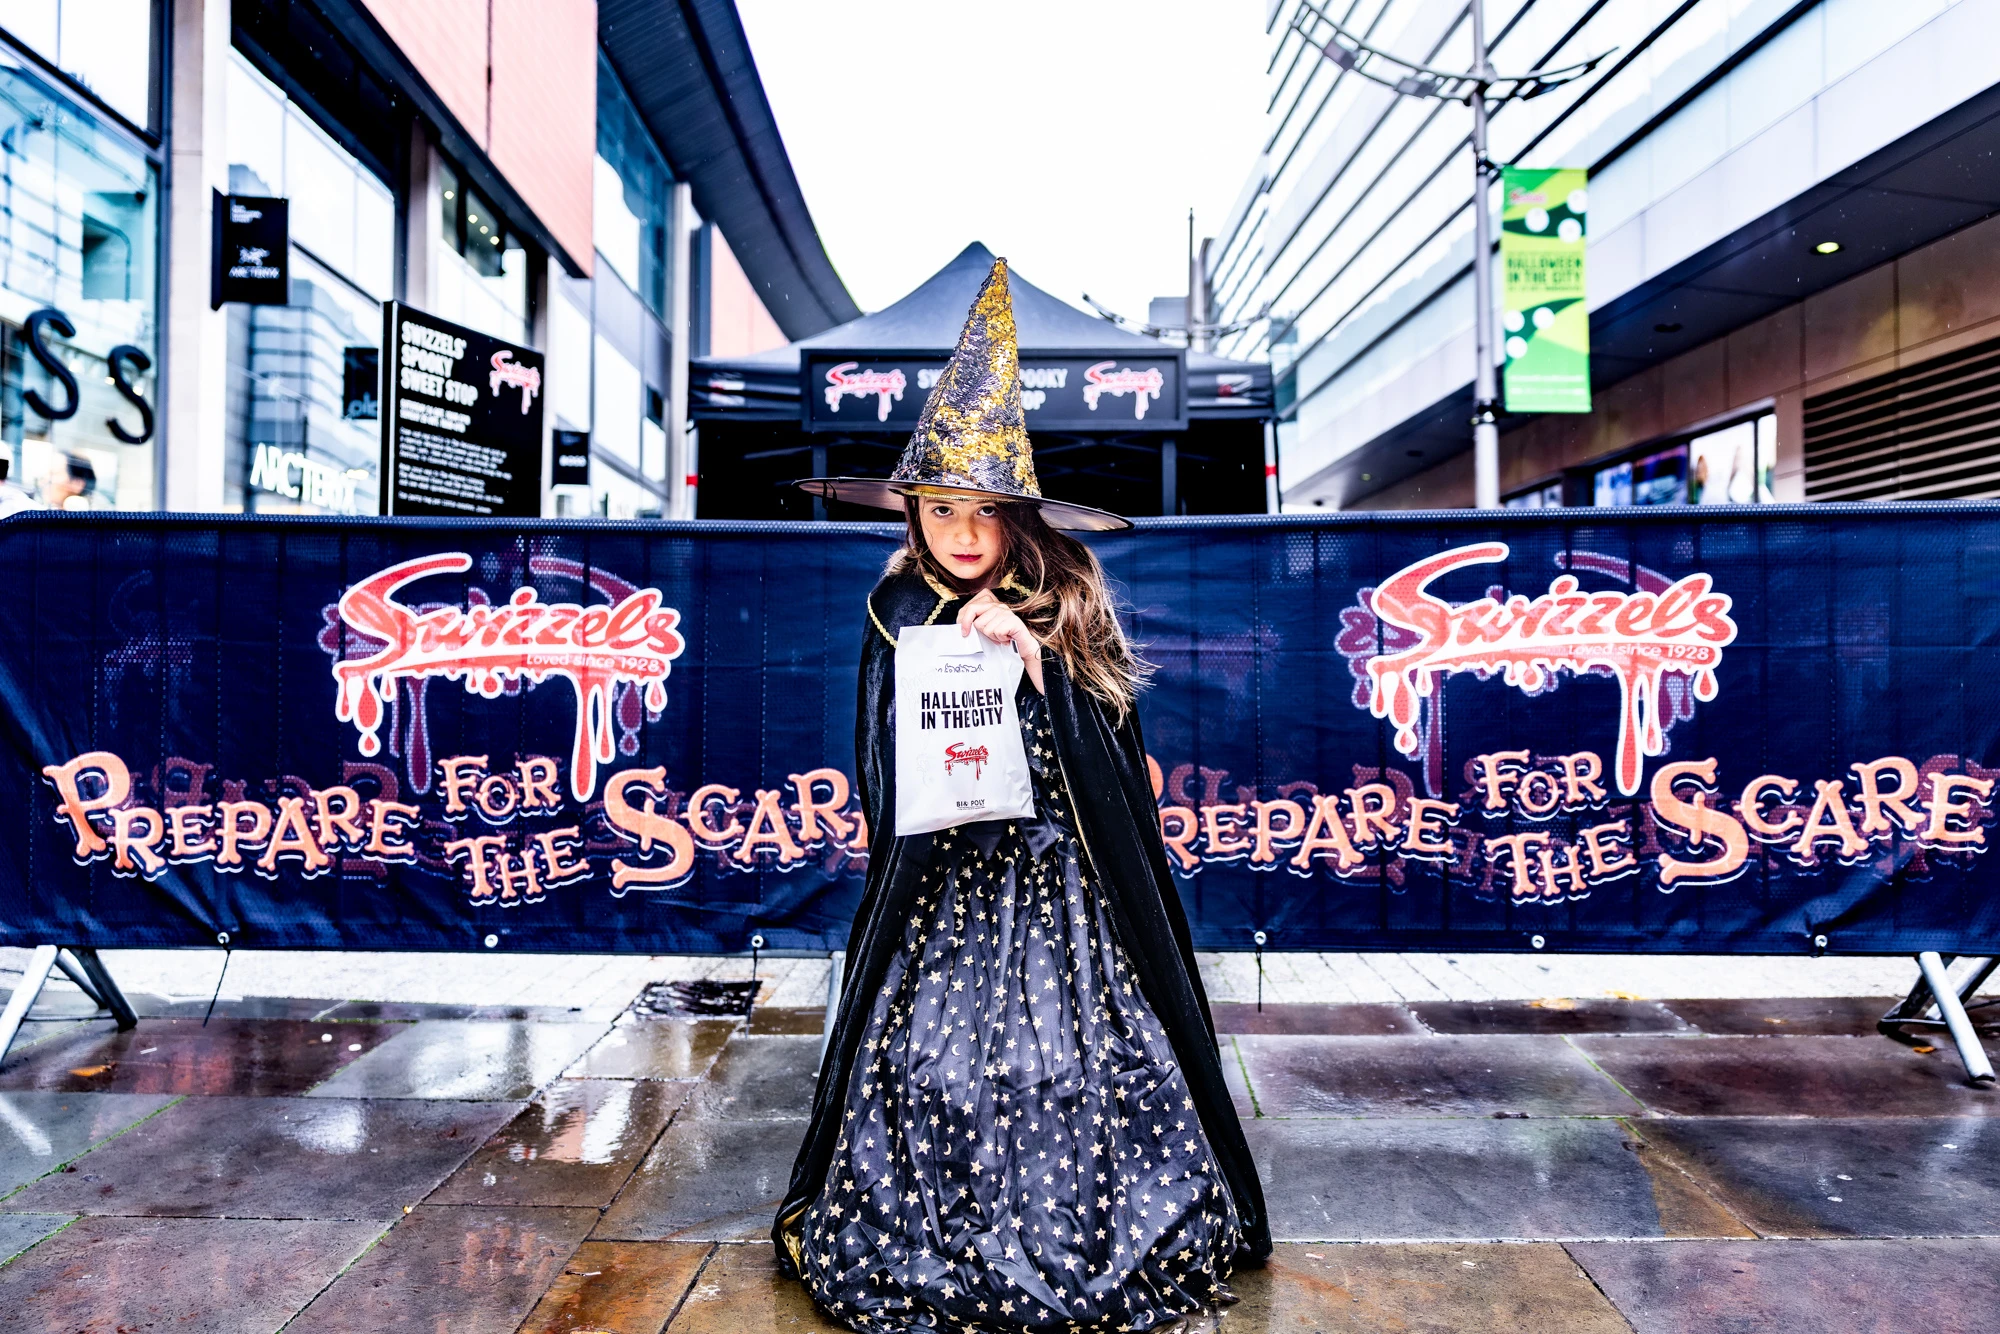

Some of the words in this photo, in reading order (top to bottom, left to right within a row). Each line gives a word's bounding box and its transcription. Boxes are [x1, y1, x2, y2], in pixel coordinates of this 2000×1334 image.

[400, 366, 445, 398] SWEET
[445, 379, 478, 407] STOP
[401, 343, 453, 378] SPOOKY
[336, 552, 685, 682] Swizzels
[1368, 542, 1738, 672] Swizzels
[526, 653, 569, 666] Loved
[573, 654, 616, 668] since
[620, 656, 660, 673] 1928
[1568, 643, 1614, 656] Loved
[1617, 643, 1662, 657] since
[1667, 644, 1710, 660] 1928
[921, 688, 1003, 710] HALLOWEEN
[921, 711, 936, 729] IN
[941, 710, 971, 728] THE
[971, 707, 1003, 728] CITY
[43, 751, 421, 876] PREPARE
[437, 754, 562, 820] FOR
[1145, 755, 1460, 875] REPARE
[1477, 749, 1607, 816] FOR
[602, 766, 869, 892] SCAR
[1650, 756, 1994, 888] SCARE
[444, 825, 591, 900] THE
[1485, 819, 1638, 898] THE
